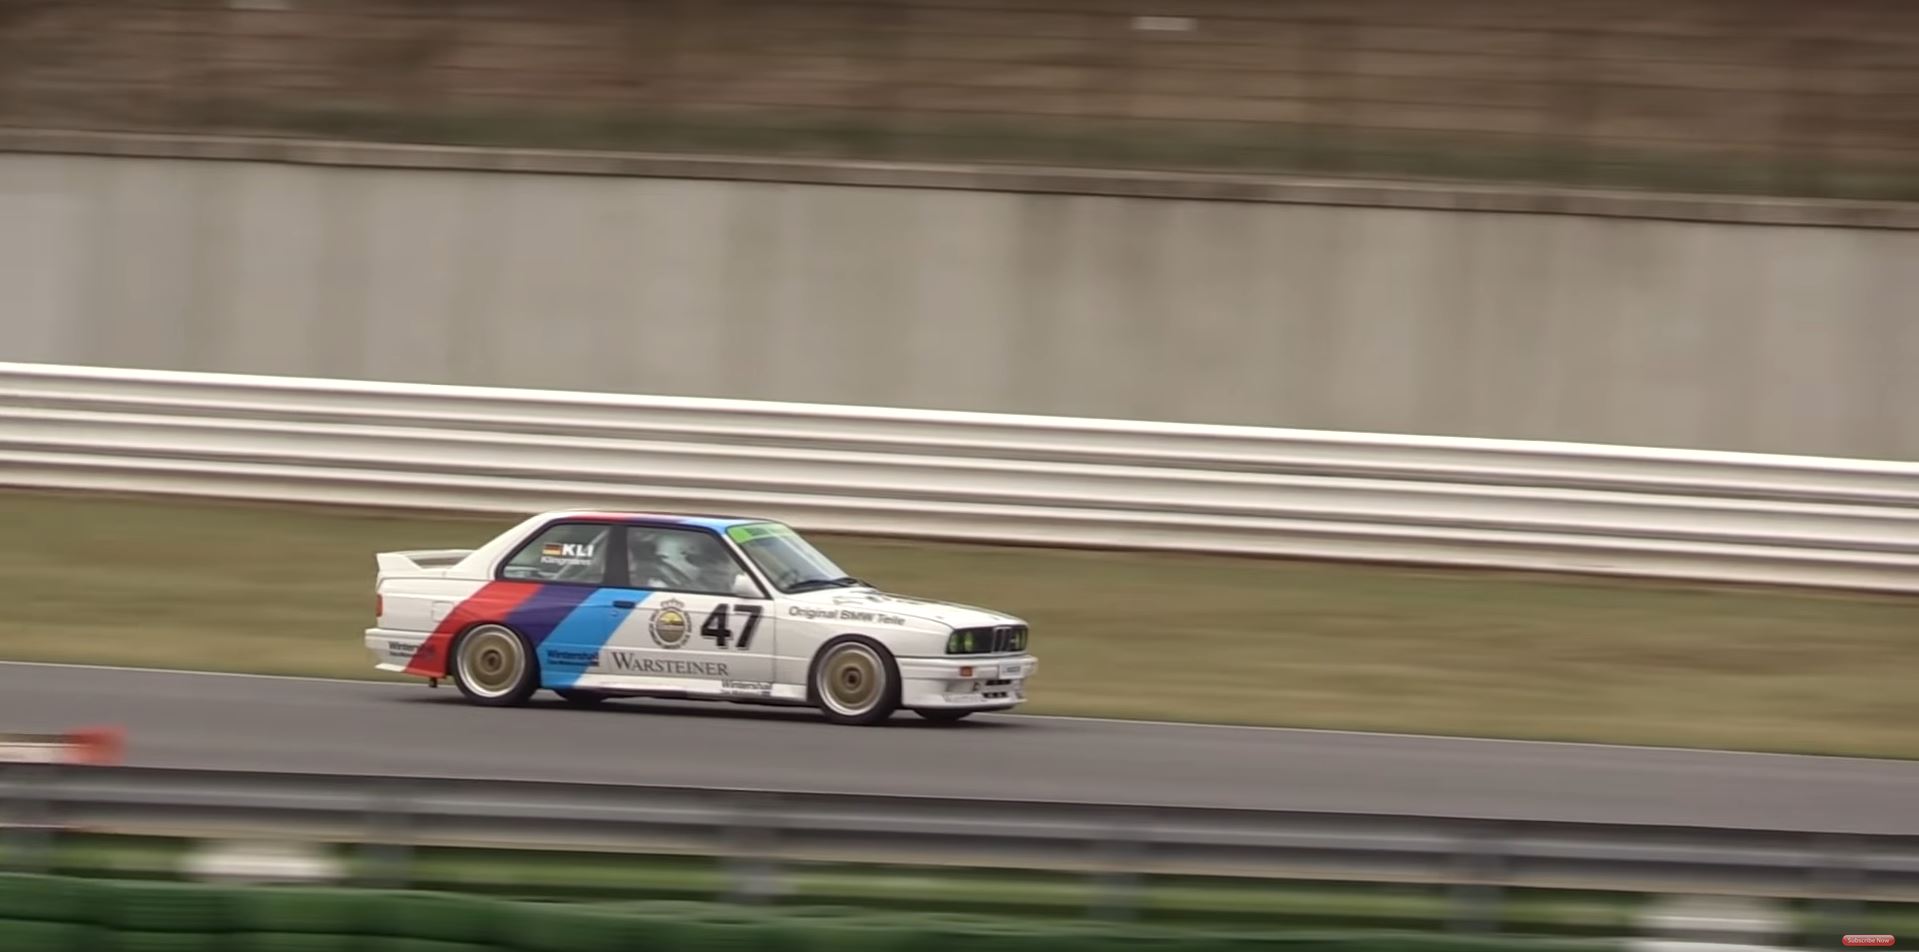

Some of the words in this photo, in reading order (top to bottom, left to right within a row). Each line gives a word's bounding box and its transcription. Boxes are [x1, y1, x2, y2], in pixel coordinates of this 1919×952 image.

[562, 543, 594, 557] KLI
[788, 606, 838, 619] Original
[840, 610, 875, 621] BMW
[877, 613, 906, 625] Teile
[701, 603, 764, 650] 47
